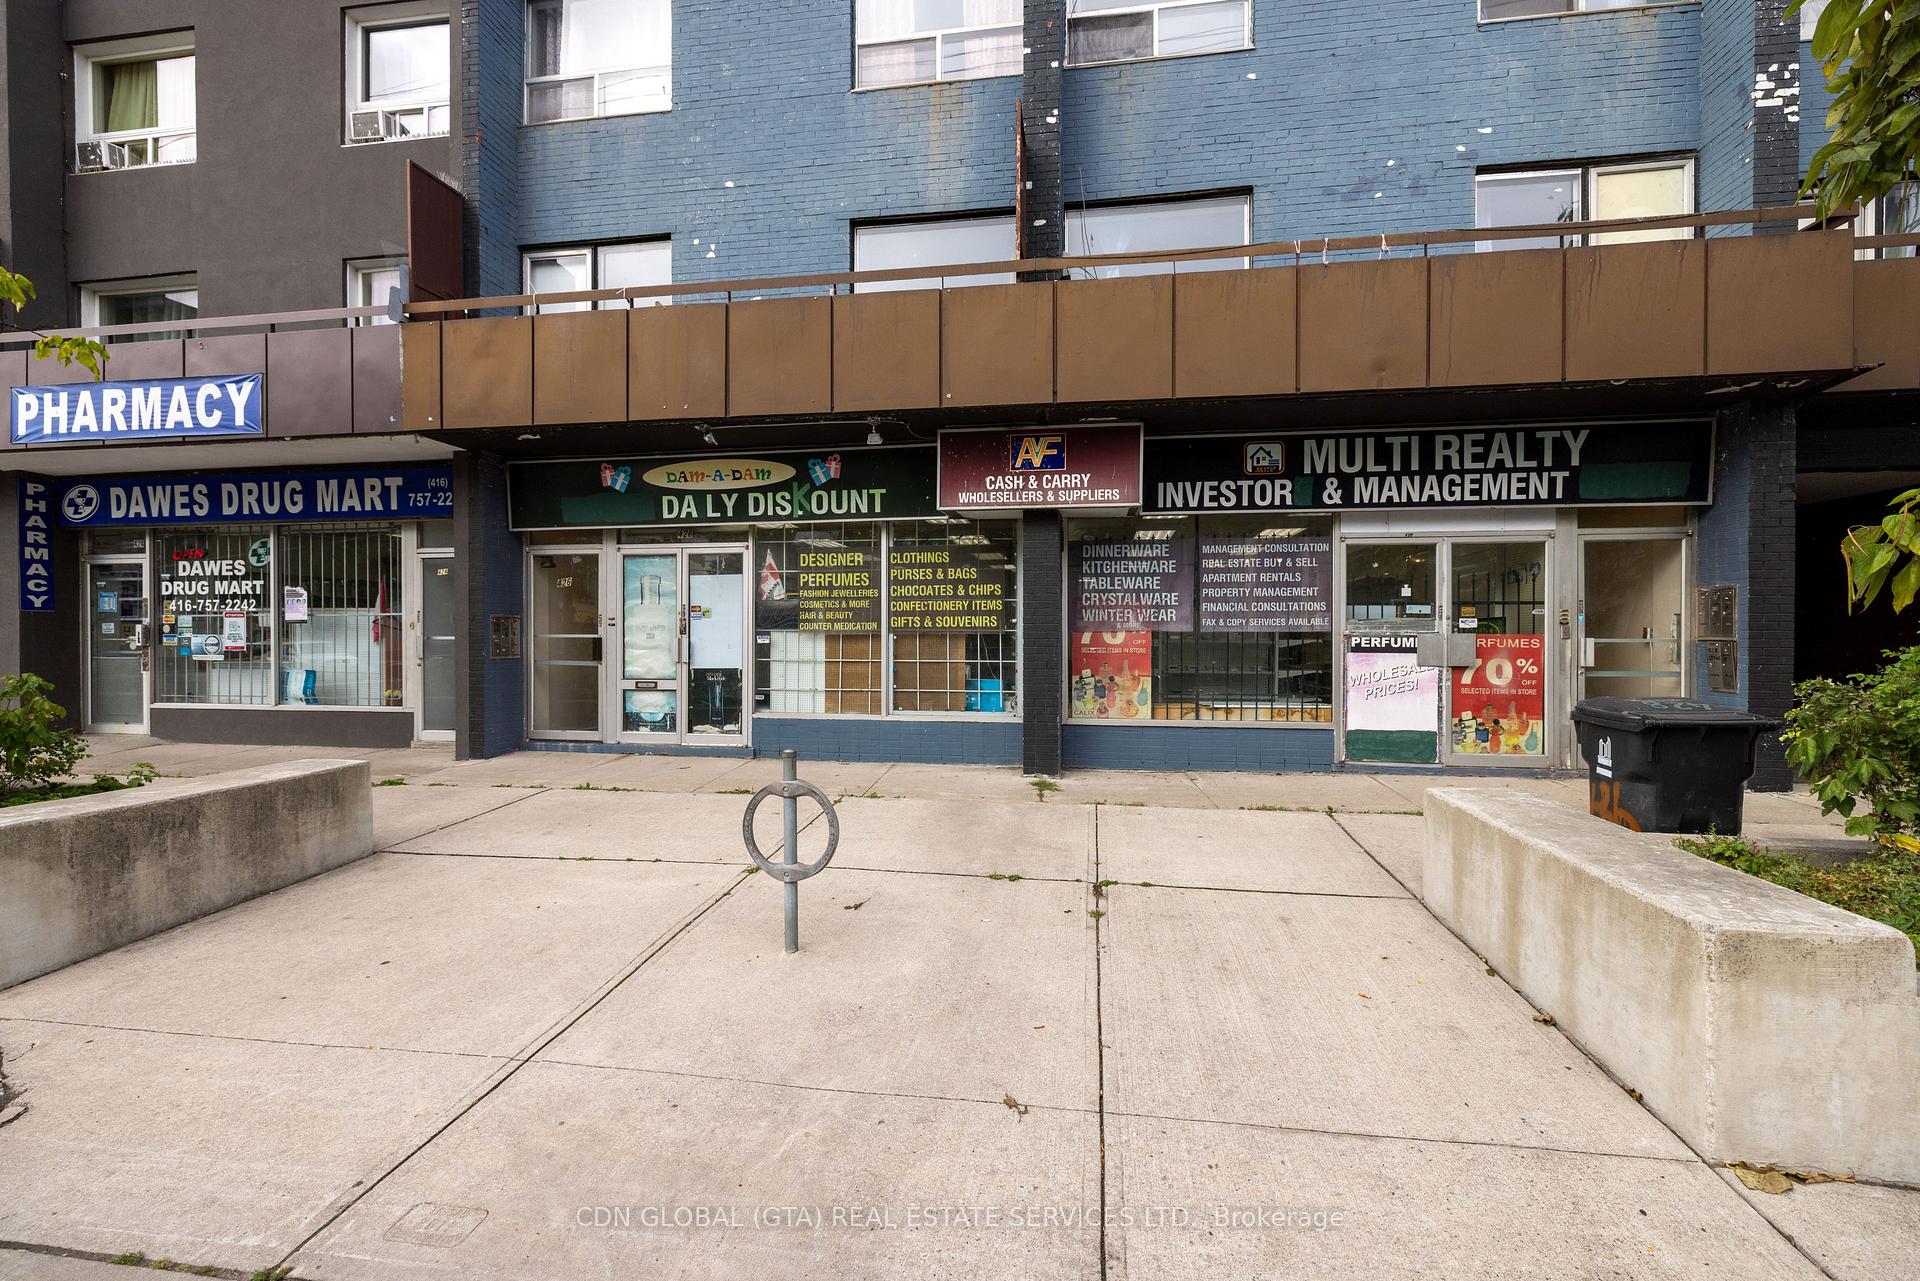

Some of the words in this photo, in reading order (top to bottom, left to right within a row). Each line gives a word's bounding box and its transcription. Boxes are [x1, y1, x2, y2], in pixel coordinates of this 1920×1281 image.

[17, 382, 254, 436] PHARMACY
[1015, 436, 1061, 468] AVF
[1303, 436, 1419, 474] MULTI
[1434, 429, 1590, 470] REALTY
[427, 477, 448, 489] (416)
[986, 475, 1024, 490] CASH
[1028, 475, 1038, 489] &
[1042, 473, 1091, 488] CARRY
[959, 490, 1043, 504] WHOLESELLERS
[1048, 491, 1054, 502] &
[1058, 488, 1120, 502] SUPPLIERS
[1157, 479, 1293, 508] INVESTOR
[1322, 478, 1342, 504] &
[1354, 471, 1569, 503] MANAGEMENT
[110, 484, 209, 519] DAWES
[221, 480, 303, 516] DRUG
[316, 477, 403, 513] MART
[408, 492, 453, 507] 757-22
[24, 482, 48, 607] PHARMACY
[1082, 544, 1170, 558] DINNERWARE
[1202, 544, 1262, 554] MANAGEMENT
[1264, 543, 1329, 552] CONSULTATION
[800, 552, 864, 567] DESIGNER
[890, 552, 950, 564] CLOTHINGS
[1202, 559, 1225, 568] REAL
[1228, 558, 1261, 568] ESTATE
[1264, 558, 1283, 567] BUY
[1286, 558, 1292, 567] &
[1295, 557, 1318, 567] SELL
[178, 559, 246, 577] DAWES
[890, 568, 933, 580] PURSES
[936, 568, 944, 580] &
[948, 567, 977, 579] BAGS
[1082, 560, 1177, 574] KITCHENWARE
[800, 572, 870, 587] PERFUMES
[1082, 576, 1161, 590] TABLEWARE
[1202, 572, 1257, 582] APARTMENT
[1260, 572, 1302, 582] RENTALS
[161, 580, 209, 596] DRUG
[214, 580, 264, 595] MART
[831, 589, 879, 597] JEWELLERIES
[890, 584, 953, 597] CHOCOATES
[957, 584, 965, 596] &
[968, 583, 1002, 596] CHIPS
[1202, 588, 1251, 597] PROPERTY
[1253, 587, 1319, 597] MANAGEMENT
[169, 599, 256, 612] 416-757-2242
[800, 600, 840, 608] COSMETICS
[841, 600, 847, 608] &
[849, 600, 870, 608] MORE
[890, 600, 969, 611] CONFECTIONERY
[972, 600, 1003, 611] ITEMS
[1082, 592, 1179, 606] CRYSTALWARE
[1202, 602, 1249, 612] FINANCIAL
[1251, 602, 1327, 612] CONSULTATIONS
[818, 611, 824, 619] &
[825, 611, 853, 619] BEAUTY
[890, 616, 921, 627] GIFTS
[924, 616, 932, 627] &
[935, 615, 998, 628] SOUVENIRS
[1082, 608, 1133, 622] WINTER
[1138, 608, 1177, 622] WEAR
[1202, 618, 1217, 626] FAX
[1219, 618, 1225, 626] &
[1226, 618, 1247, 626] COPY
[1249, 618, 1286, 626] SERVICES
[1288, 617, 1329, 626] AVAILABLE
[800, 622, 832, 630] COUNTER
[834, 622, 877, 630] MEDICATION
[1477, 638, 1540, 648] RFUMES
[1365, 678, 1419, 700] PRICES!
